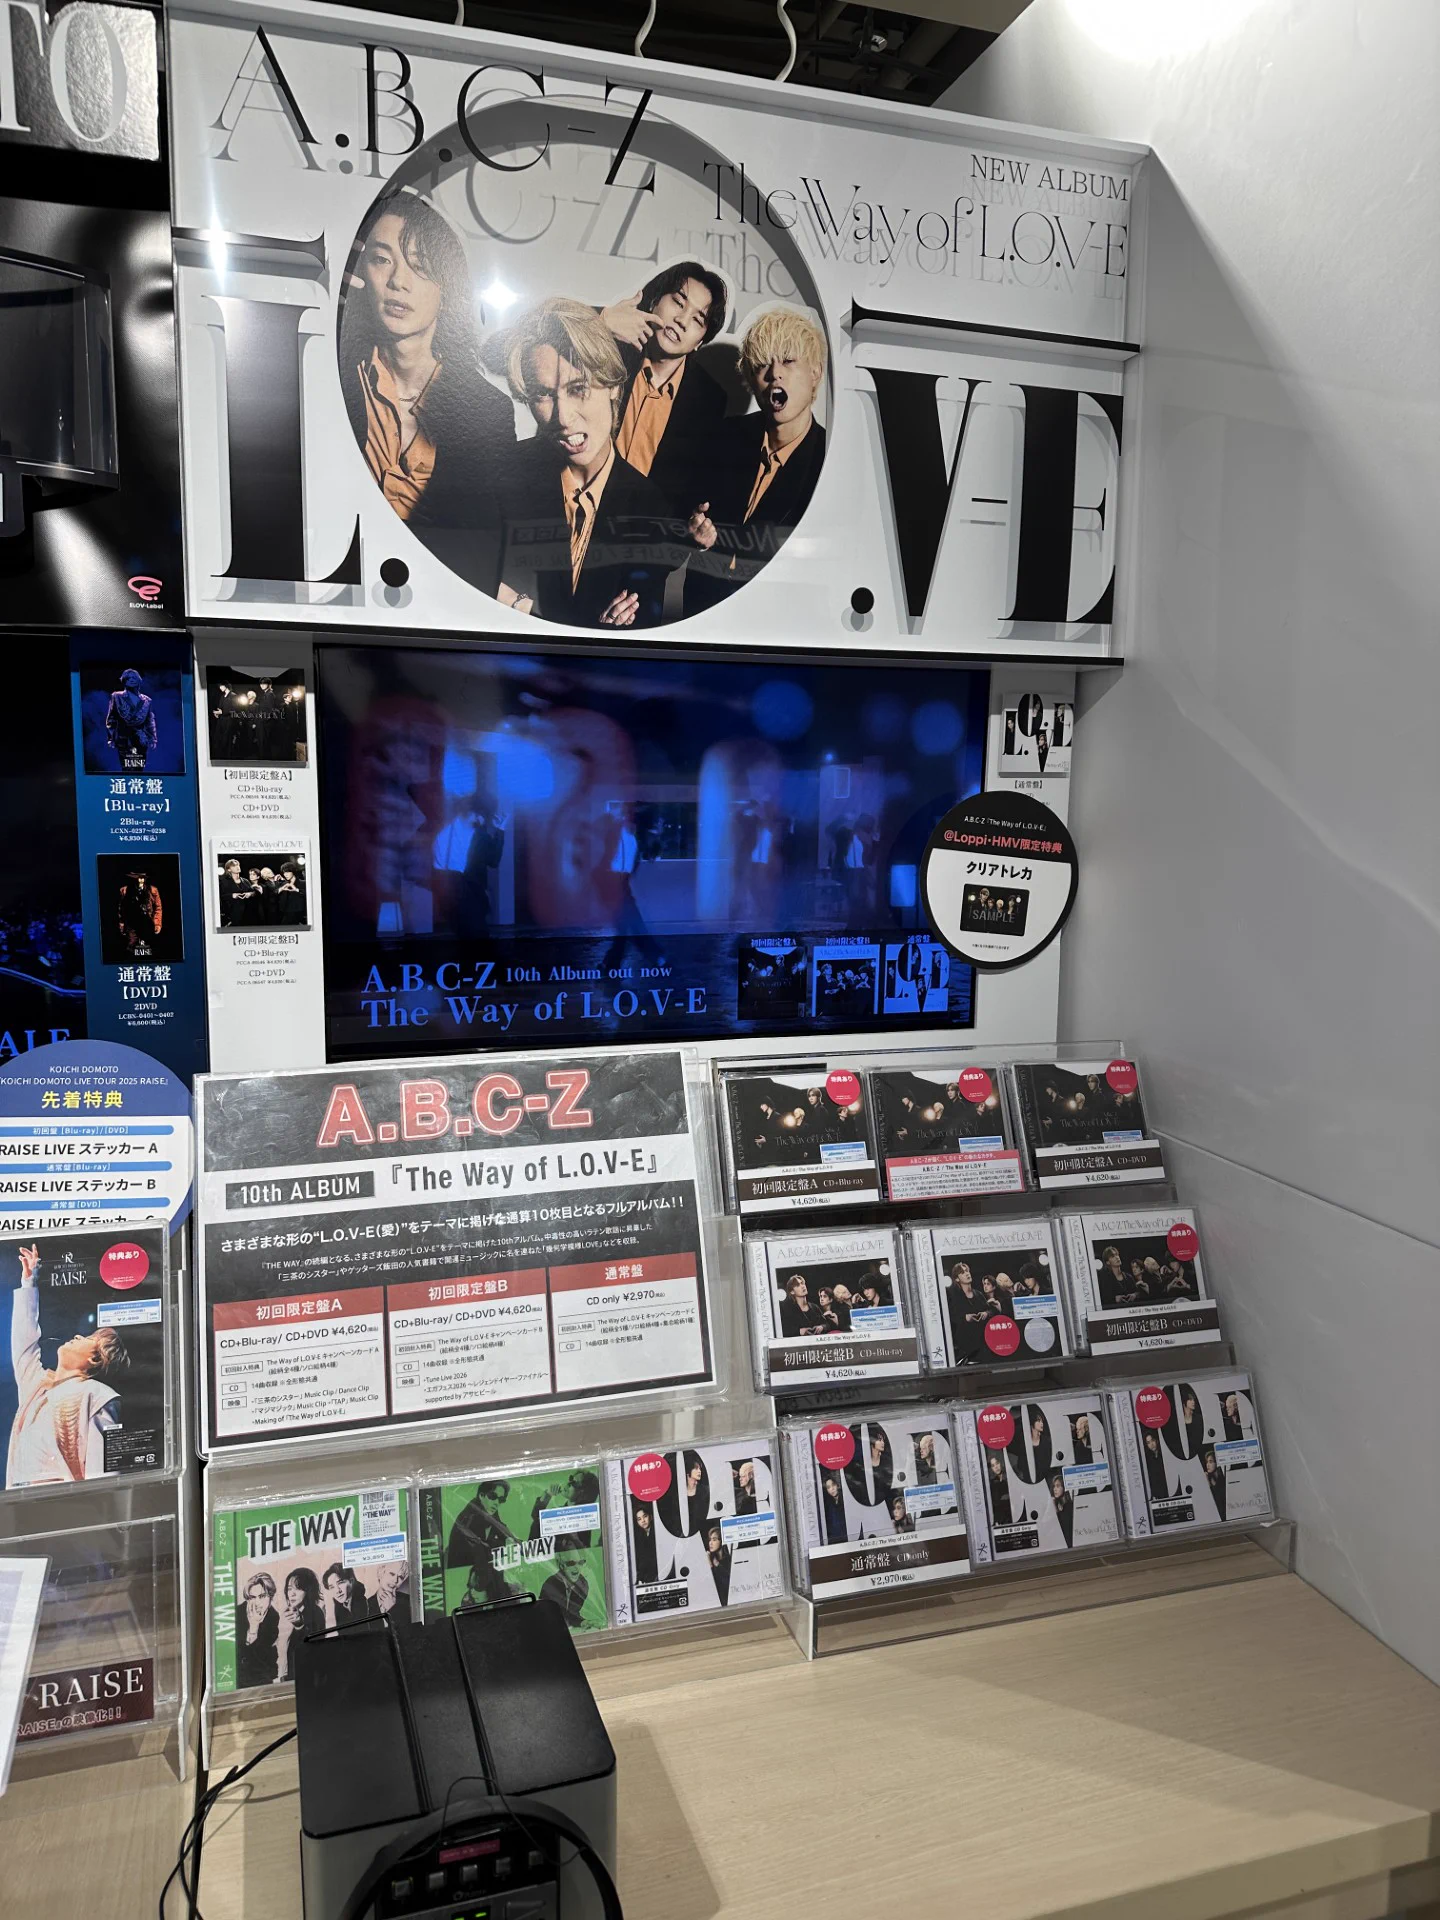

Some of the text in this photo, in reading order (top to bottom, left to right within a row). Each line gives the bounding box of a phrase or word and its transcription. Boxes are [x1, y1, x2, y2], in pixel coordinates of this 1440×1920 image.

[970, 154, 1129, 202] NEW ALBUM
[703, 162, 798, 231] The
[799, 177, 910, 264] Way
[916, 196, 973, 254] of
[110, 778, 164, 795] 通常盤
[237, 785, 283, 794] CD+Blu-ray
[242, 804, 280, 812] CD+DVD
[120, 818, 156, 827] 2Blu-ray
[1001, 819, 1014, 829] Way
[1014, 820, 1022, 829] of
[966, 860, 1033, 881] クリアトレカ
[972, 909, 1016, 924] SAMPLE
[244, 949, 289, 958] CD+Blu-ray
[118, 965, 172, 983] 通常盤
[249, 969, 286, 977] CD+DVD
[361, 962, 673, 994] A.B.C-Z 10th Album out now
[360, 987, 708, 1031] The Way of L.O.V-E
[50, 1065, 119, 1074] KOICHI DOMOTO
[74, 1077, 92, 1085] LIVE
[94, 1077, 117, 1085] TOUR
[118, 1077, 138, 1085] 2025
[41, 1090, 124, 1109] 先着特典
[316, 1068, 594, 1149] A.B.C-Z
[0, 1142, 158, 1156] RAISE LIVE ステッカー A
[1053, 1156, 1114, 1171] 初回限定盤A
[41, 1181, 73, 1192] LIVE
[76, 1179, 143, 1192] ステッカー
[147, 1179, 156, 1190] B
[240, 1184, 282, 1205] 10th
[290, 1176, 361, 1200] ALBUM
[462, 1160, 514, 1189] Way
[524, 1156, 548, 1181] of
[751, 1180, 819, 1195] 初回限定盤A
[108, 1250, 140, 1261] 特典あり
[51, 1271, 87, 1286] RAISE
[604, 1263, 644, 1281] 通常盤
[428, 1279, 509, 1301] 初回限定盤B
[586, 1296, 600, 1306] CD
[602, 1294, 620, 1305] only
[255, 1298, 343, 1321] 初回限定盤A
[455, 1308, 496, 1322] CD+DVD
[609, 1317, 620, 1325] Way
[1106, 1318, 1168, 1336] 初回限定盤B
[285, 1328, 329, 1342] CD+DVD
[449, 1336, 462, 1345] Way
[267, 1358, 277, 1366] The
[277, 1356, 292, 1366] Way
[784, 1348, 854, 1366] 初回限定盤B
[402, 1363, 412, 1371] CD
[440, 1374, 452, 1382] Live
[229, 1384, 239, 1392] CD
[304, 1384, 370, 1399] Music Clip Dance Clip
[297, 1393, 379, 1410] Music Clip Music Clip
[424, 1394, 454, 1404] supported
[1140, 1393, 1162, 1403] 特典あり
[276, 1412, 314, 1423] of Way
[982, 1412, 1007, 1422] 特典あり
[820, 1431, 847, 1442] 特典あり
[633, 1459, 662, 1473] 特典あり
[245, 1520, 292, 1558] THE
[300, 1507, 352, 1546] WAY
[421, 1534, 441, 1568] THE
[491, 1536, 556, 1568] THE WAY
[850, 1552, 891, 1571] 通常盤
[214, 1561, 236, 1642] THE WAY
[38, 1667, 144, 1709] RAISE
